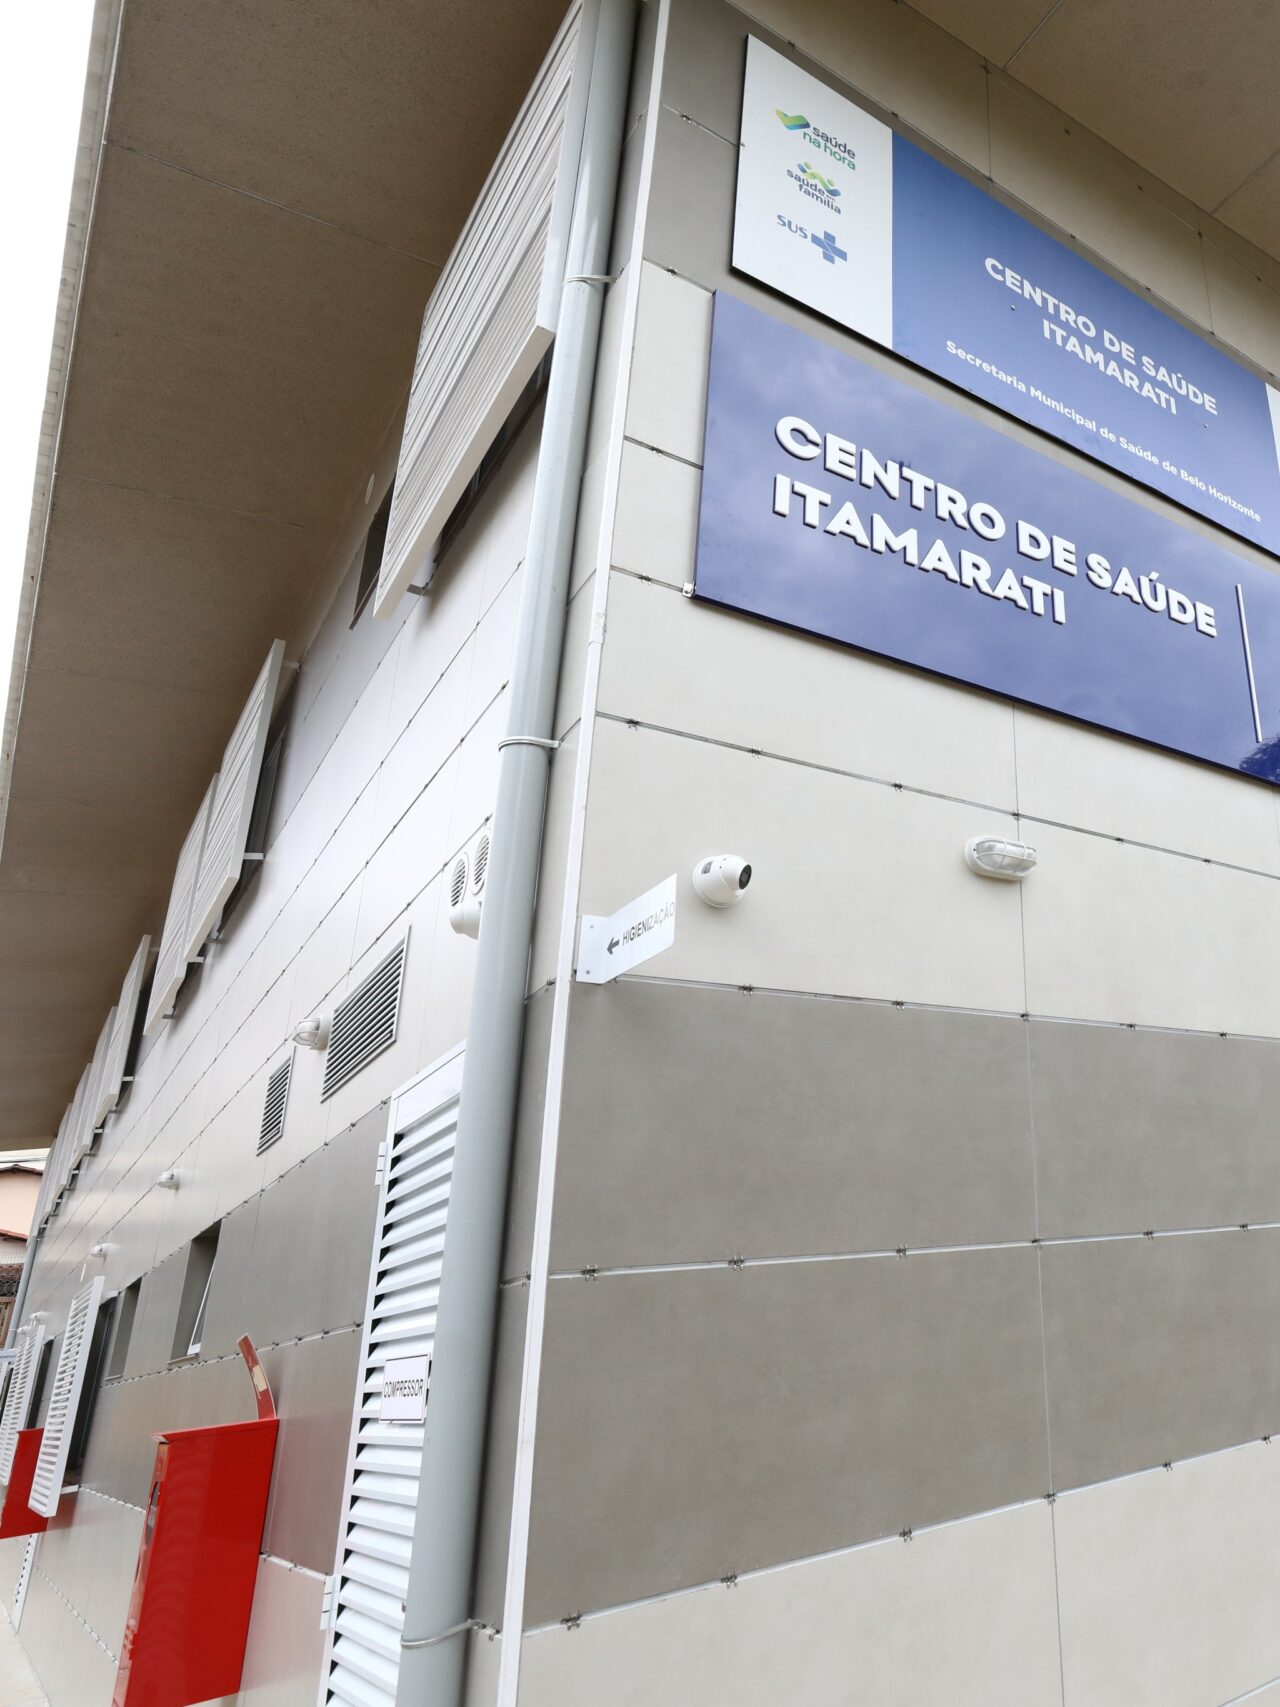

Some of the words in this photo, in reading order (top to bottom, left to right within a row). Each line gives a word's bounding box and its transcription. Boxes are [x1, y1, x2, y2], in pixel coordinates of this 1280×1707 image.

[802, 131, 821, 149] na
[823, 142, 856, 171] hora
[813, 126, 856, 160] saúde
[786, 169, 826, 197] saúde
[776, 214, 808, 240] SUS
[984, 257, 1096, 338] CENTRO
[1103, 328, 1136, 366] DE
[1142, 355, 1218, 416] SAÚDE
[1042, 318, 1177, 415] ITAMARATI
[945, 340, 1026, 393] Secretaria
[1030, 385, 1096, 432] Municipal
[1100, 419, 1117, 443] de
[1119, 436, 1159, 466] Saúde
[1162, 459, 1178, 477] de
[1180, 469, 1206, 491] Belo
[1208, 484, 1262, 523] Horizonte
[772, 472, 1067, 626] ITAMARATI
[774, 415, 1007, 542] CENTRO
[1016, 519, 1078, 577] DE
[1086, 552, 1218, 639] SAÚDE
[622, 902, 675, 946] HIGIENIZAÇÃO
[384, 1378, 423, 1398] COMPRESSOR
